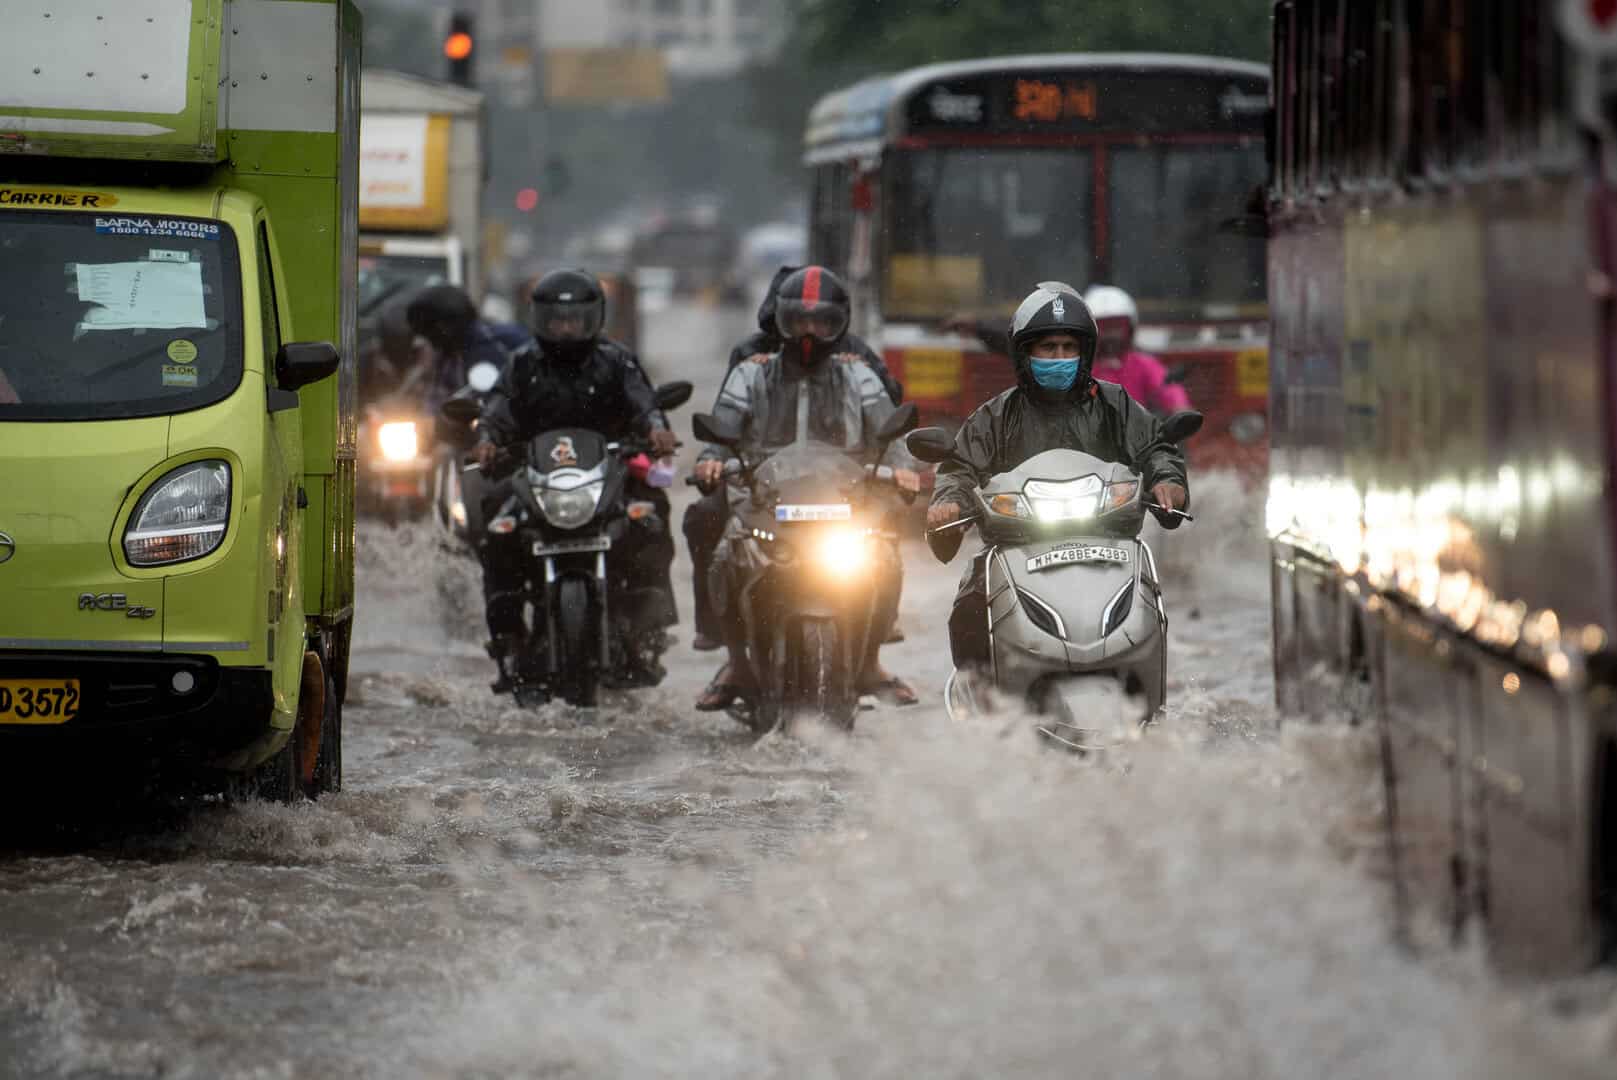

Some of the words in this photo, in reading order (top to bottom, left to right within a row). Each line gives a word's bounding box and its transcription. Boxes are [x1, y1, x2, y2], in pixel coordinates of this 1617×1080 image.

[0, 189, 100, 207] CARRIER
[96, 218, 153, 228] BAFNA
[156, 219, 219, 234] MOTORS
[110, 226, 139, 234] 1800
[144, 227, 173, 236] 1234
[79, 592, 127, 609] ACE
